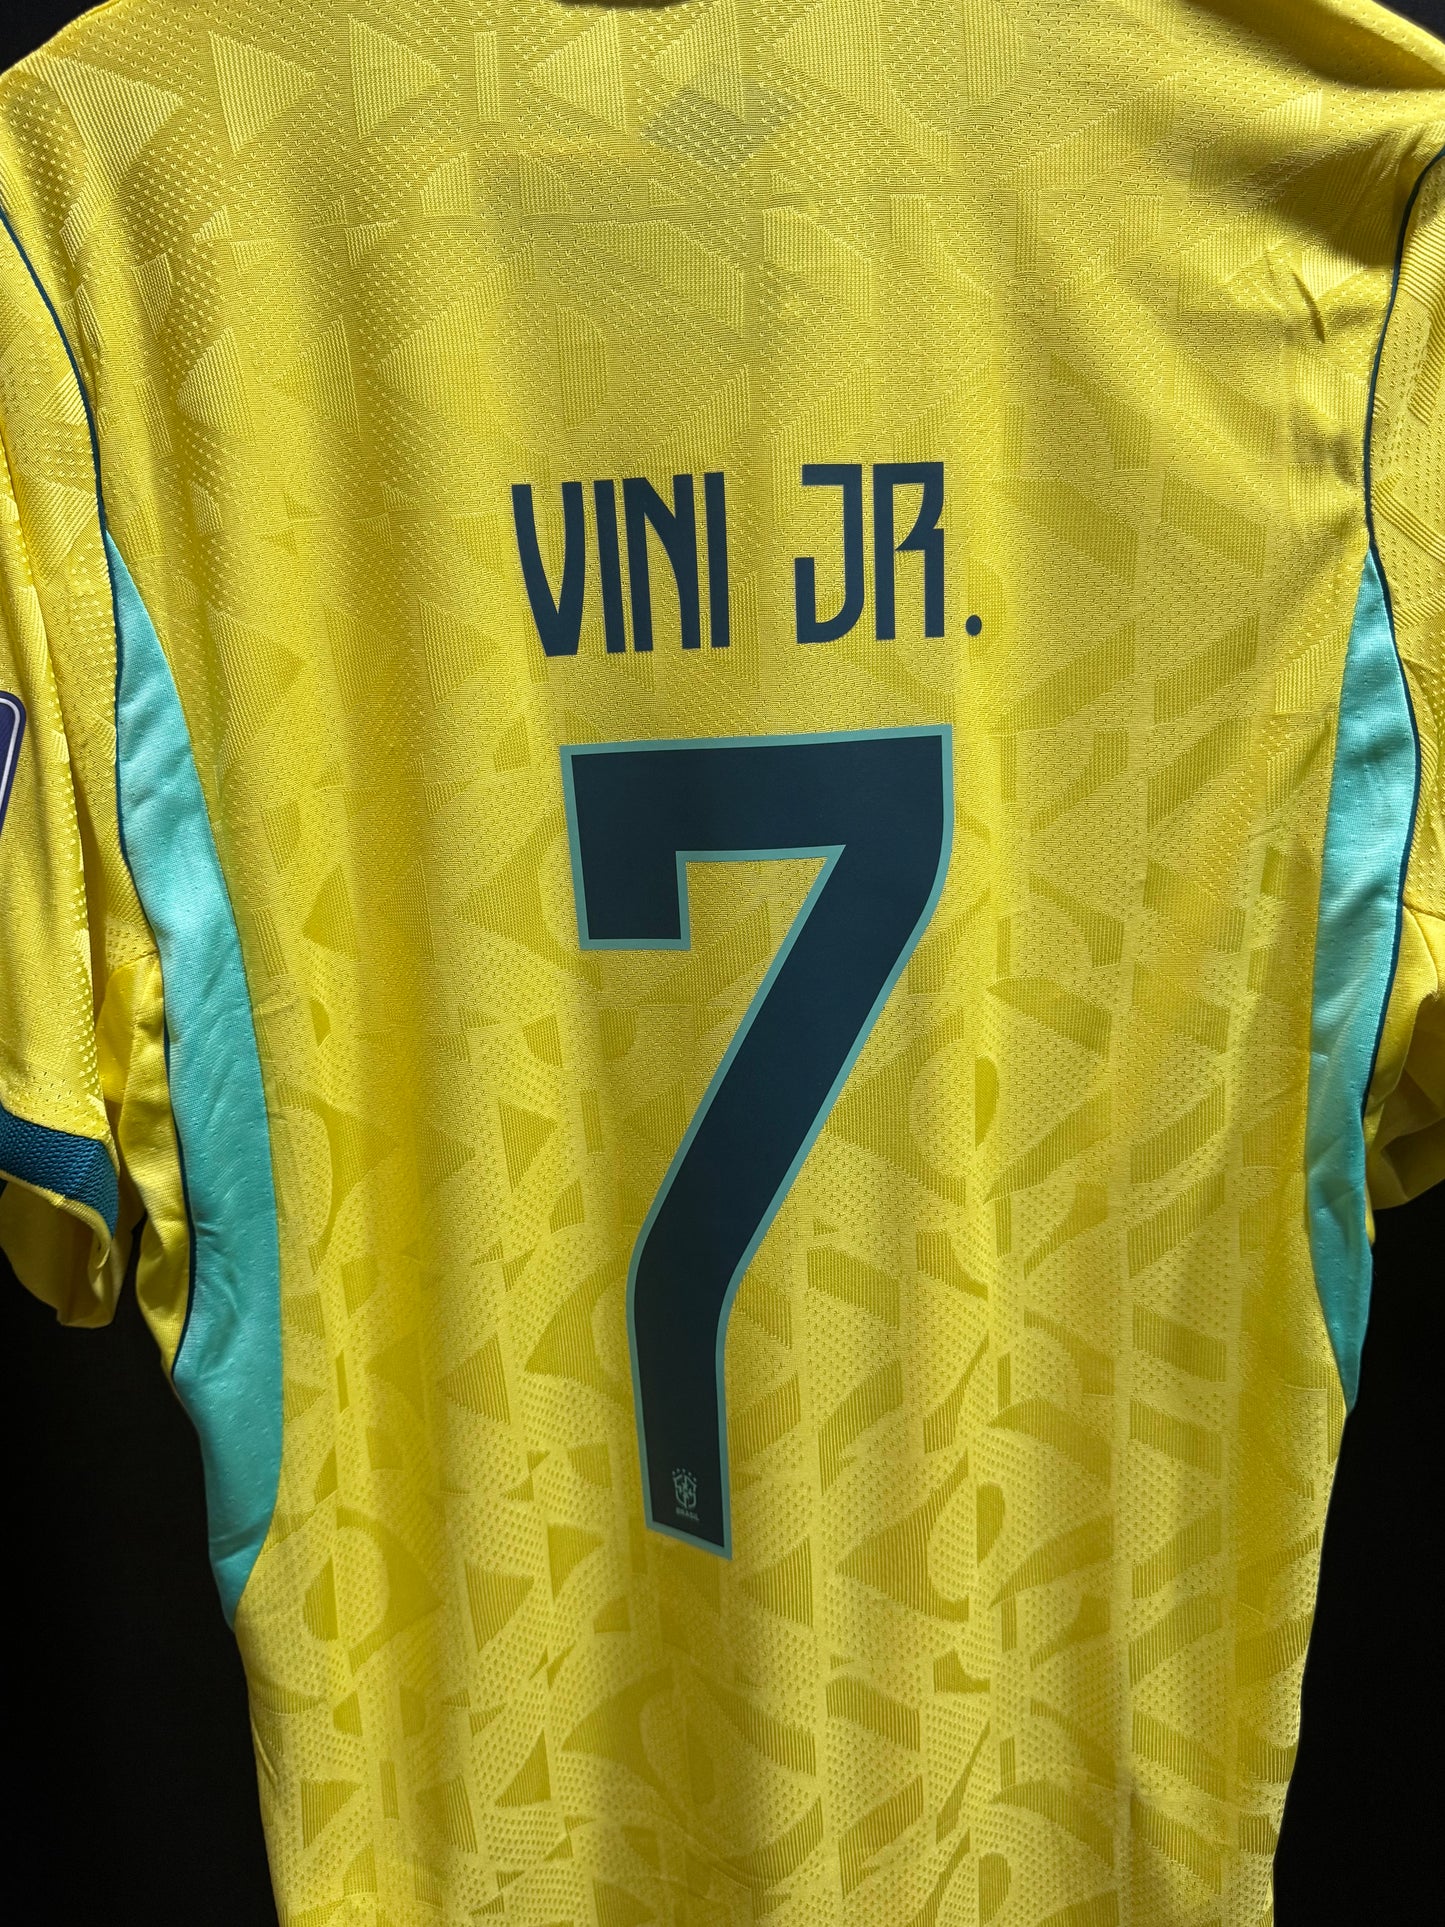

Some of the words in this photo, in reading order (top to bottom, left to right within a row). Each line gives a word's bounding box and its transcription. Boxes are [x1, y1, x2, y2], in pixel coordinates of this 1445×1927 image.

[511, 471, 731, 658] VINI
[794, 461, 983, 645] JR.
[560, 725, 954, 1561] 7
[675, 1506, 700, 1521] BRASIL
